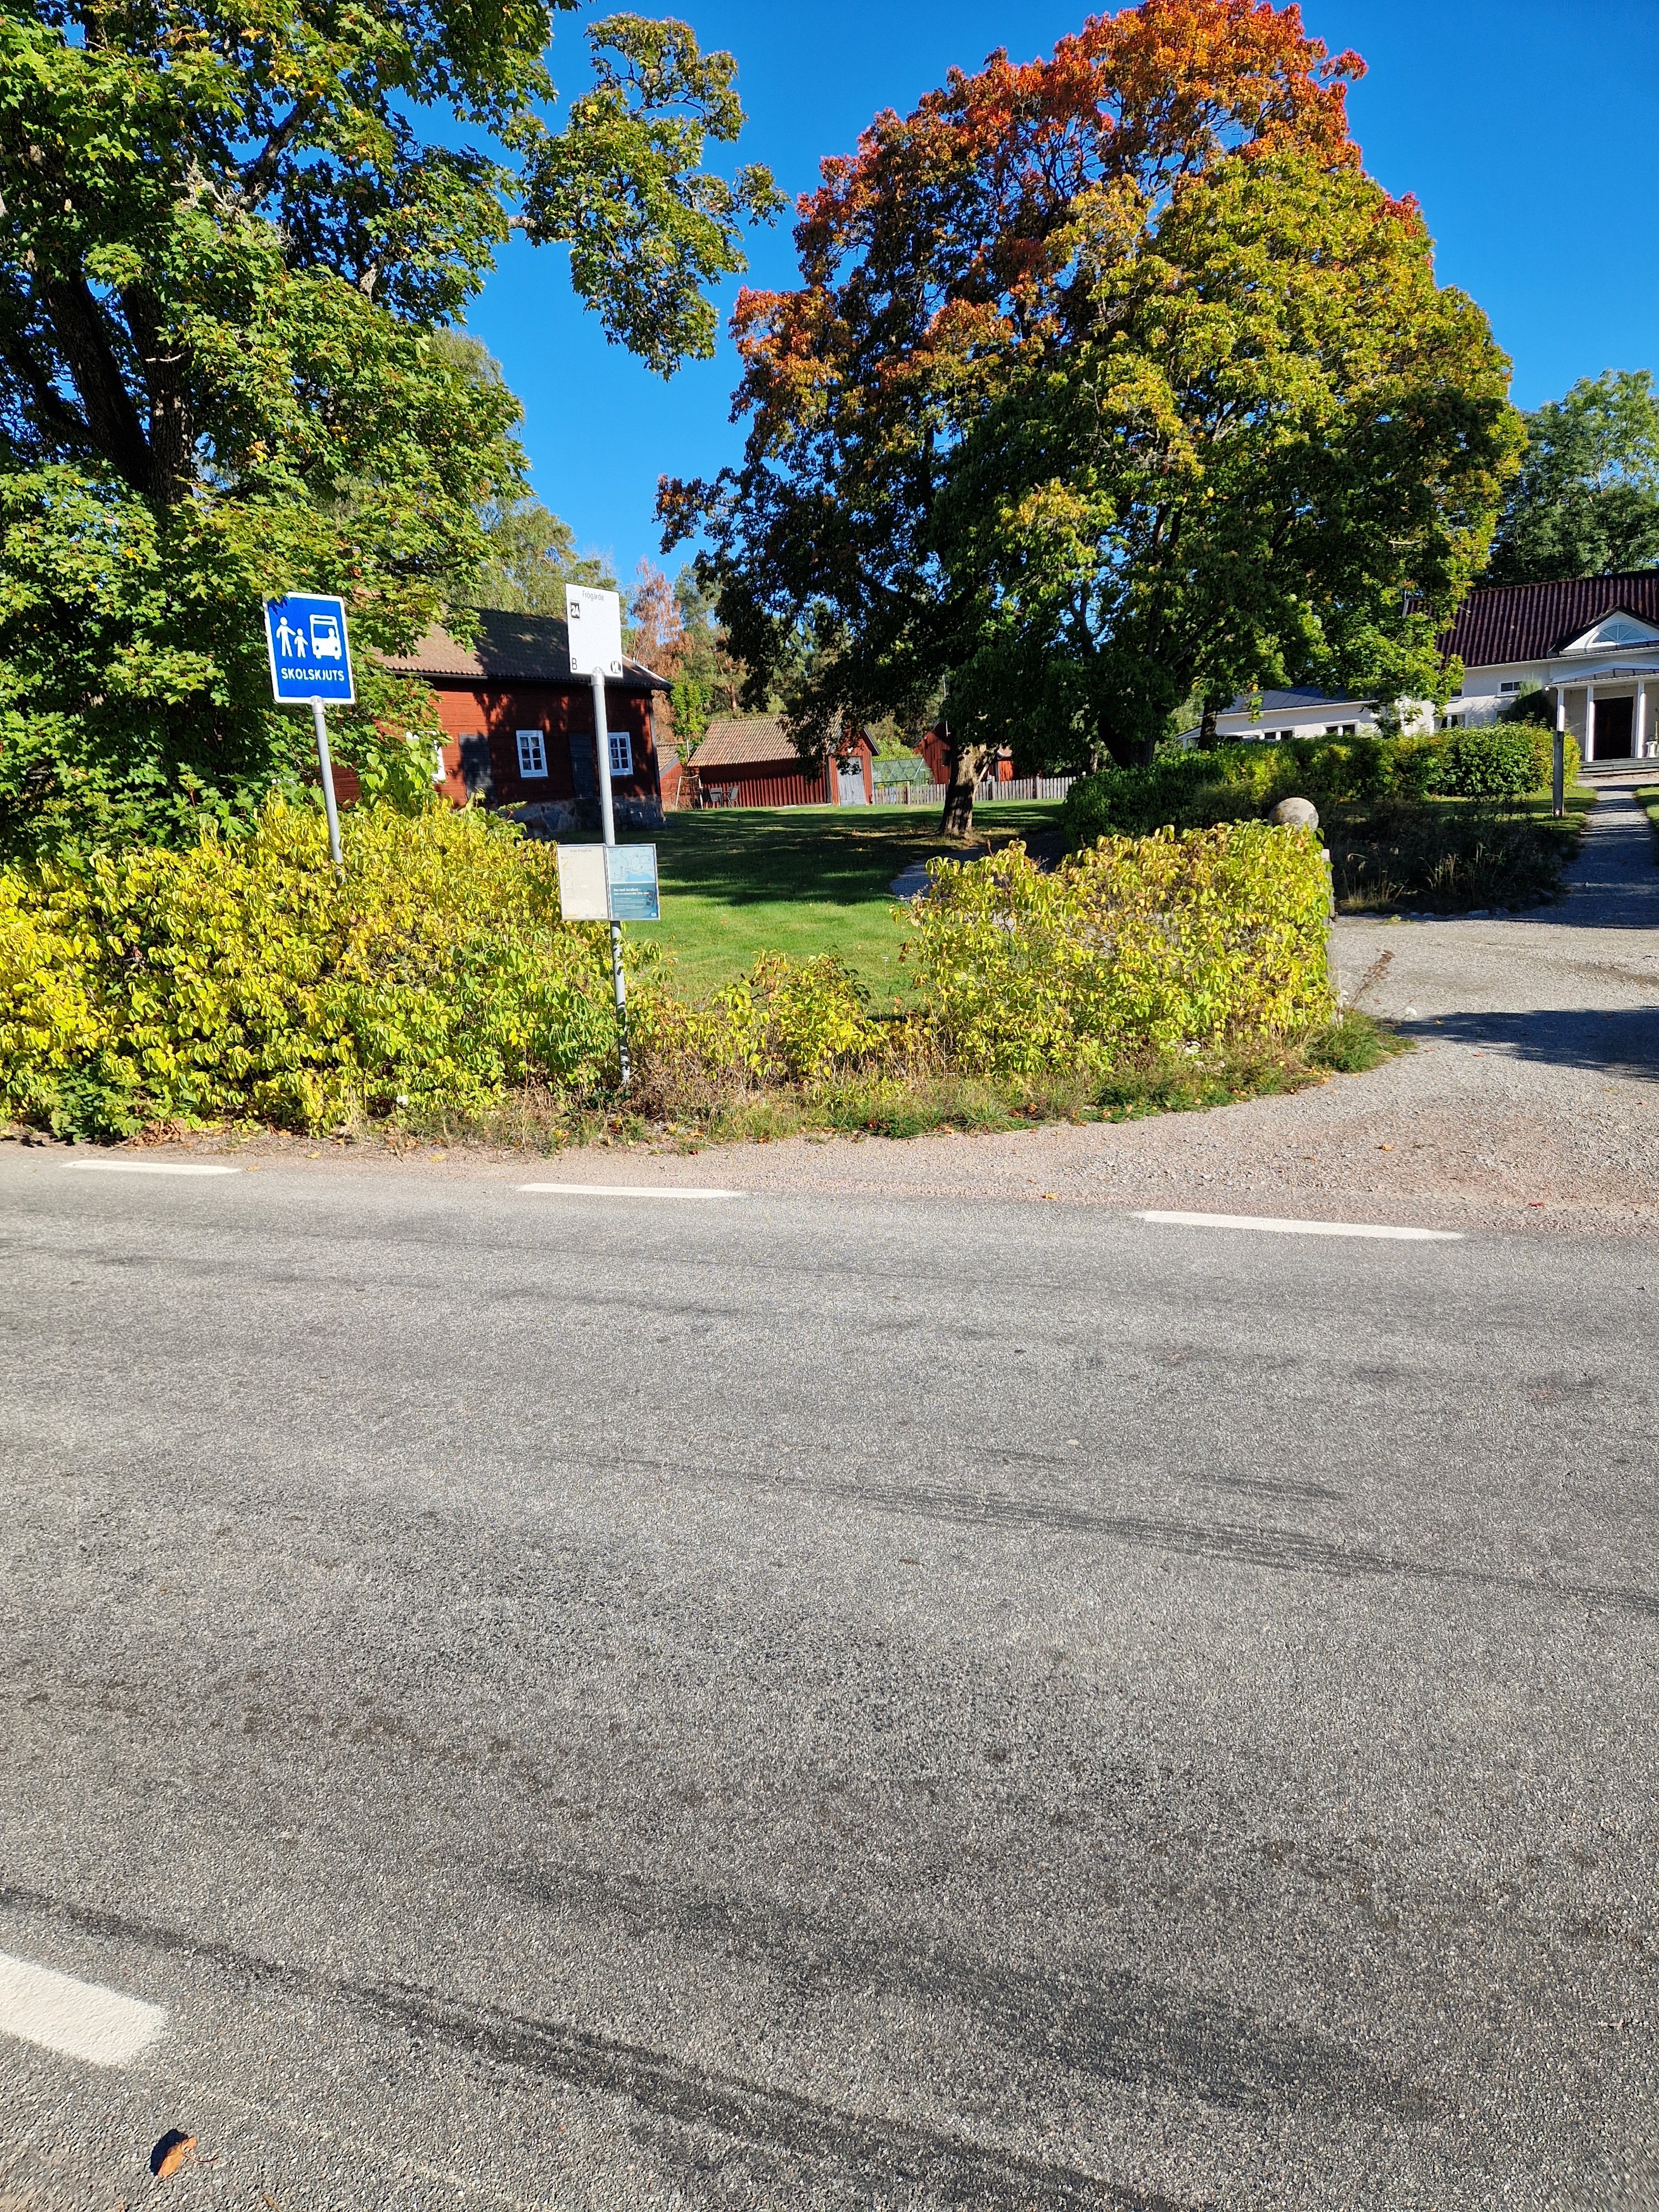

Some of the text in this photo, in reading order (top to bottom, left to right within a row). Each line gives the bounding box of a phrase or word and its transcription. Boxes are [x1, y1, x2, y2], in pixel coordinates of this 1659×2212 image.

[571, 604, 580, 618] 24
[571, 658, 577, 670] B
[281, 667, 345, 681] SKOLSKJUTS
